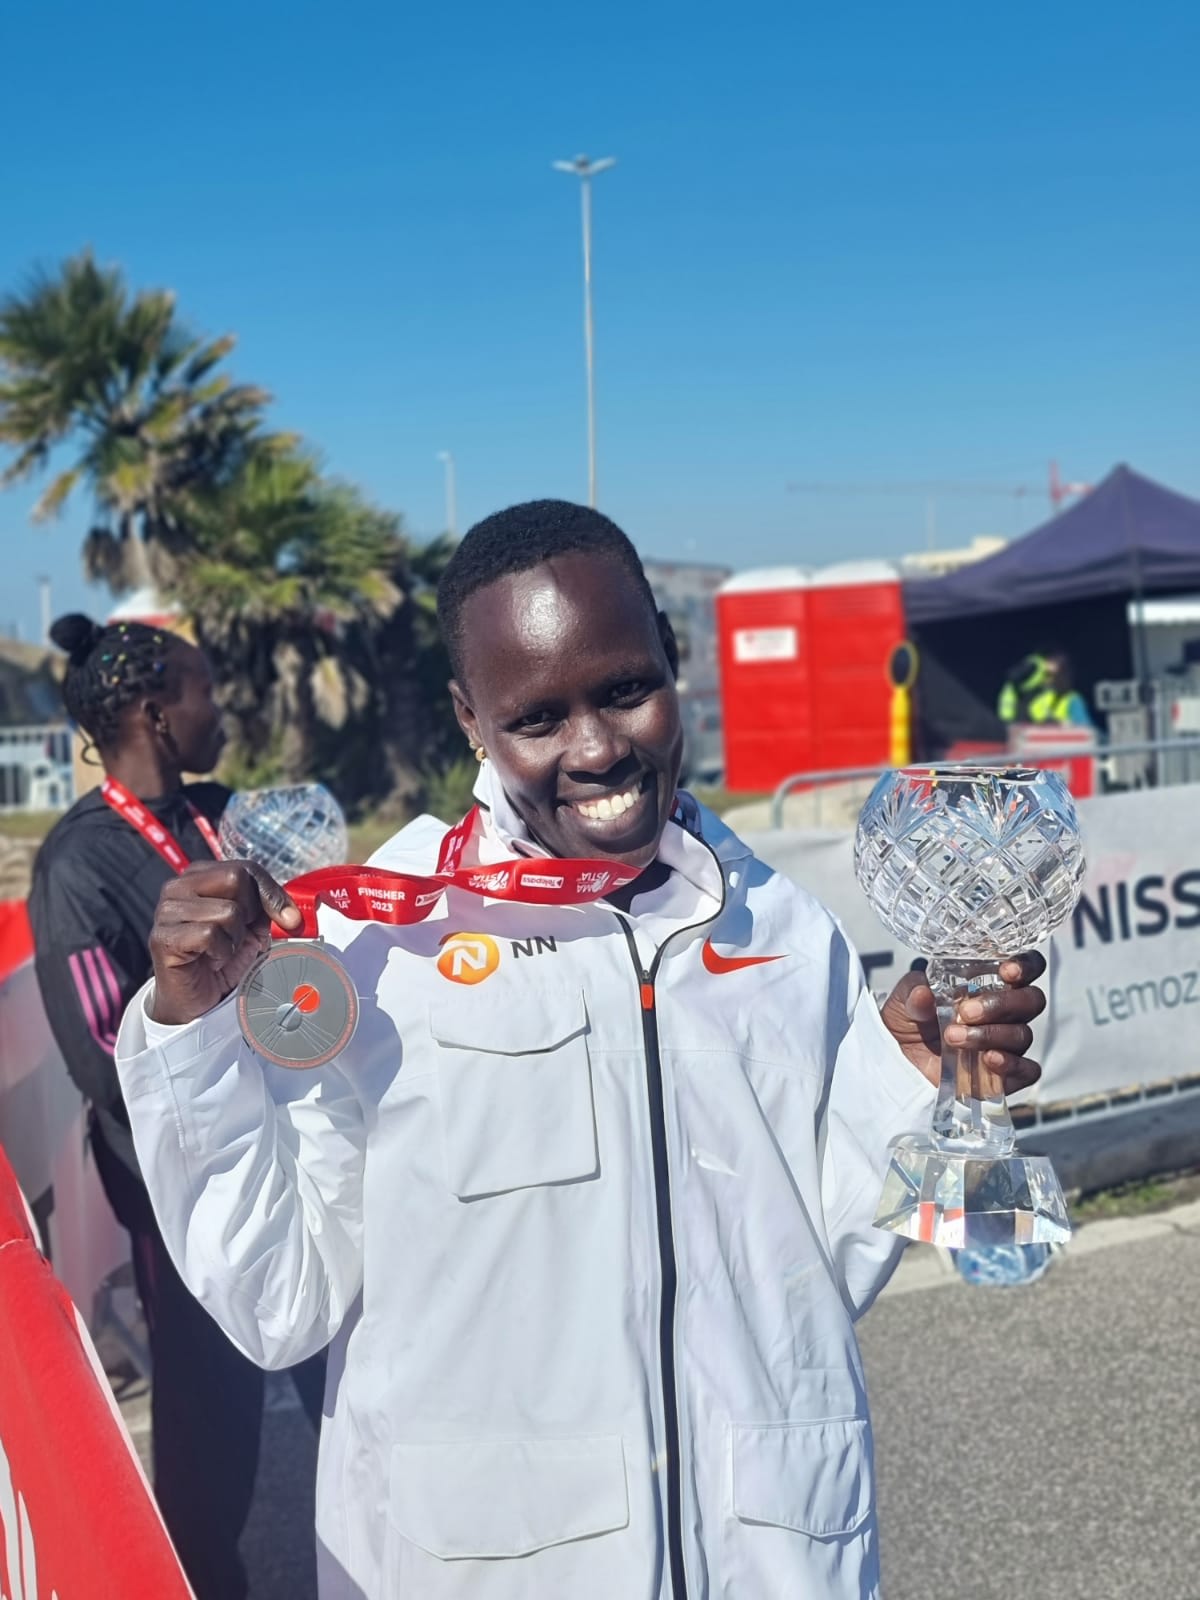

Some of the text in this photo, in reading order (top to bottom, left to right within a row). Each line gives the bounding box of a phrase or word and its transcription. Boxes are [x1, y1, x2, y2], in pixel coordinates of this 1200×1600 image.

[522, 875, 558, 887] Telepass
[358, 887, 406, 900] FINISHER
[371, 900, 393, 912] 2023
[510, 935, 557, 958] NN
